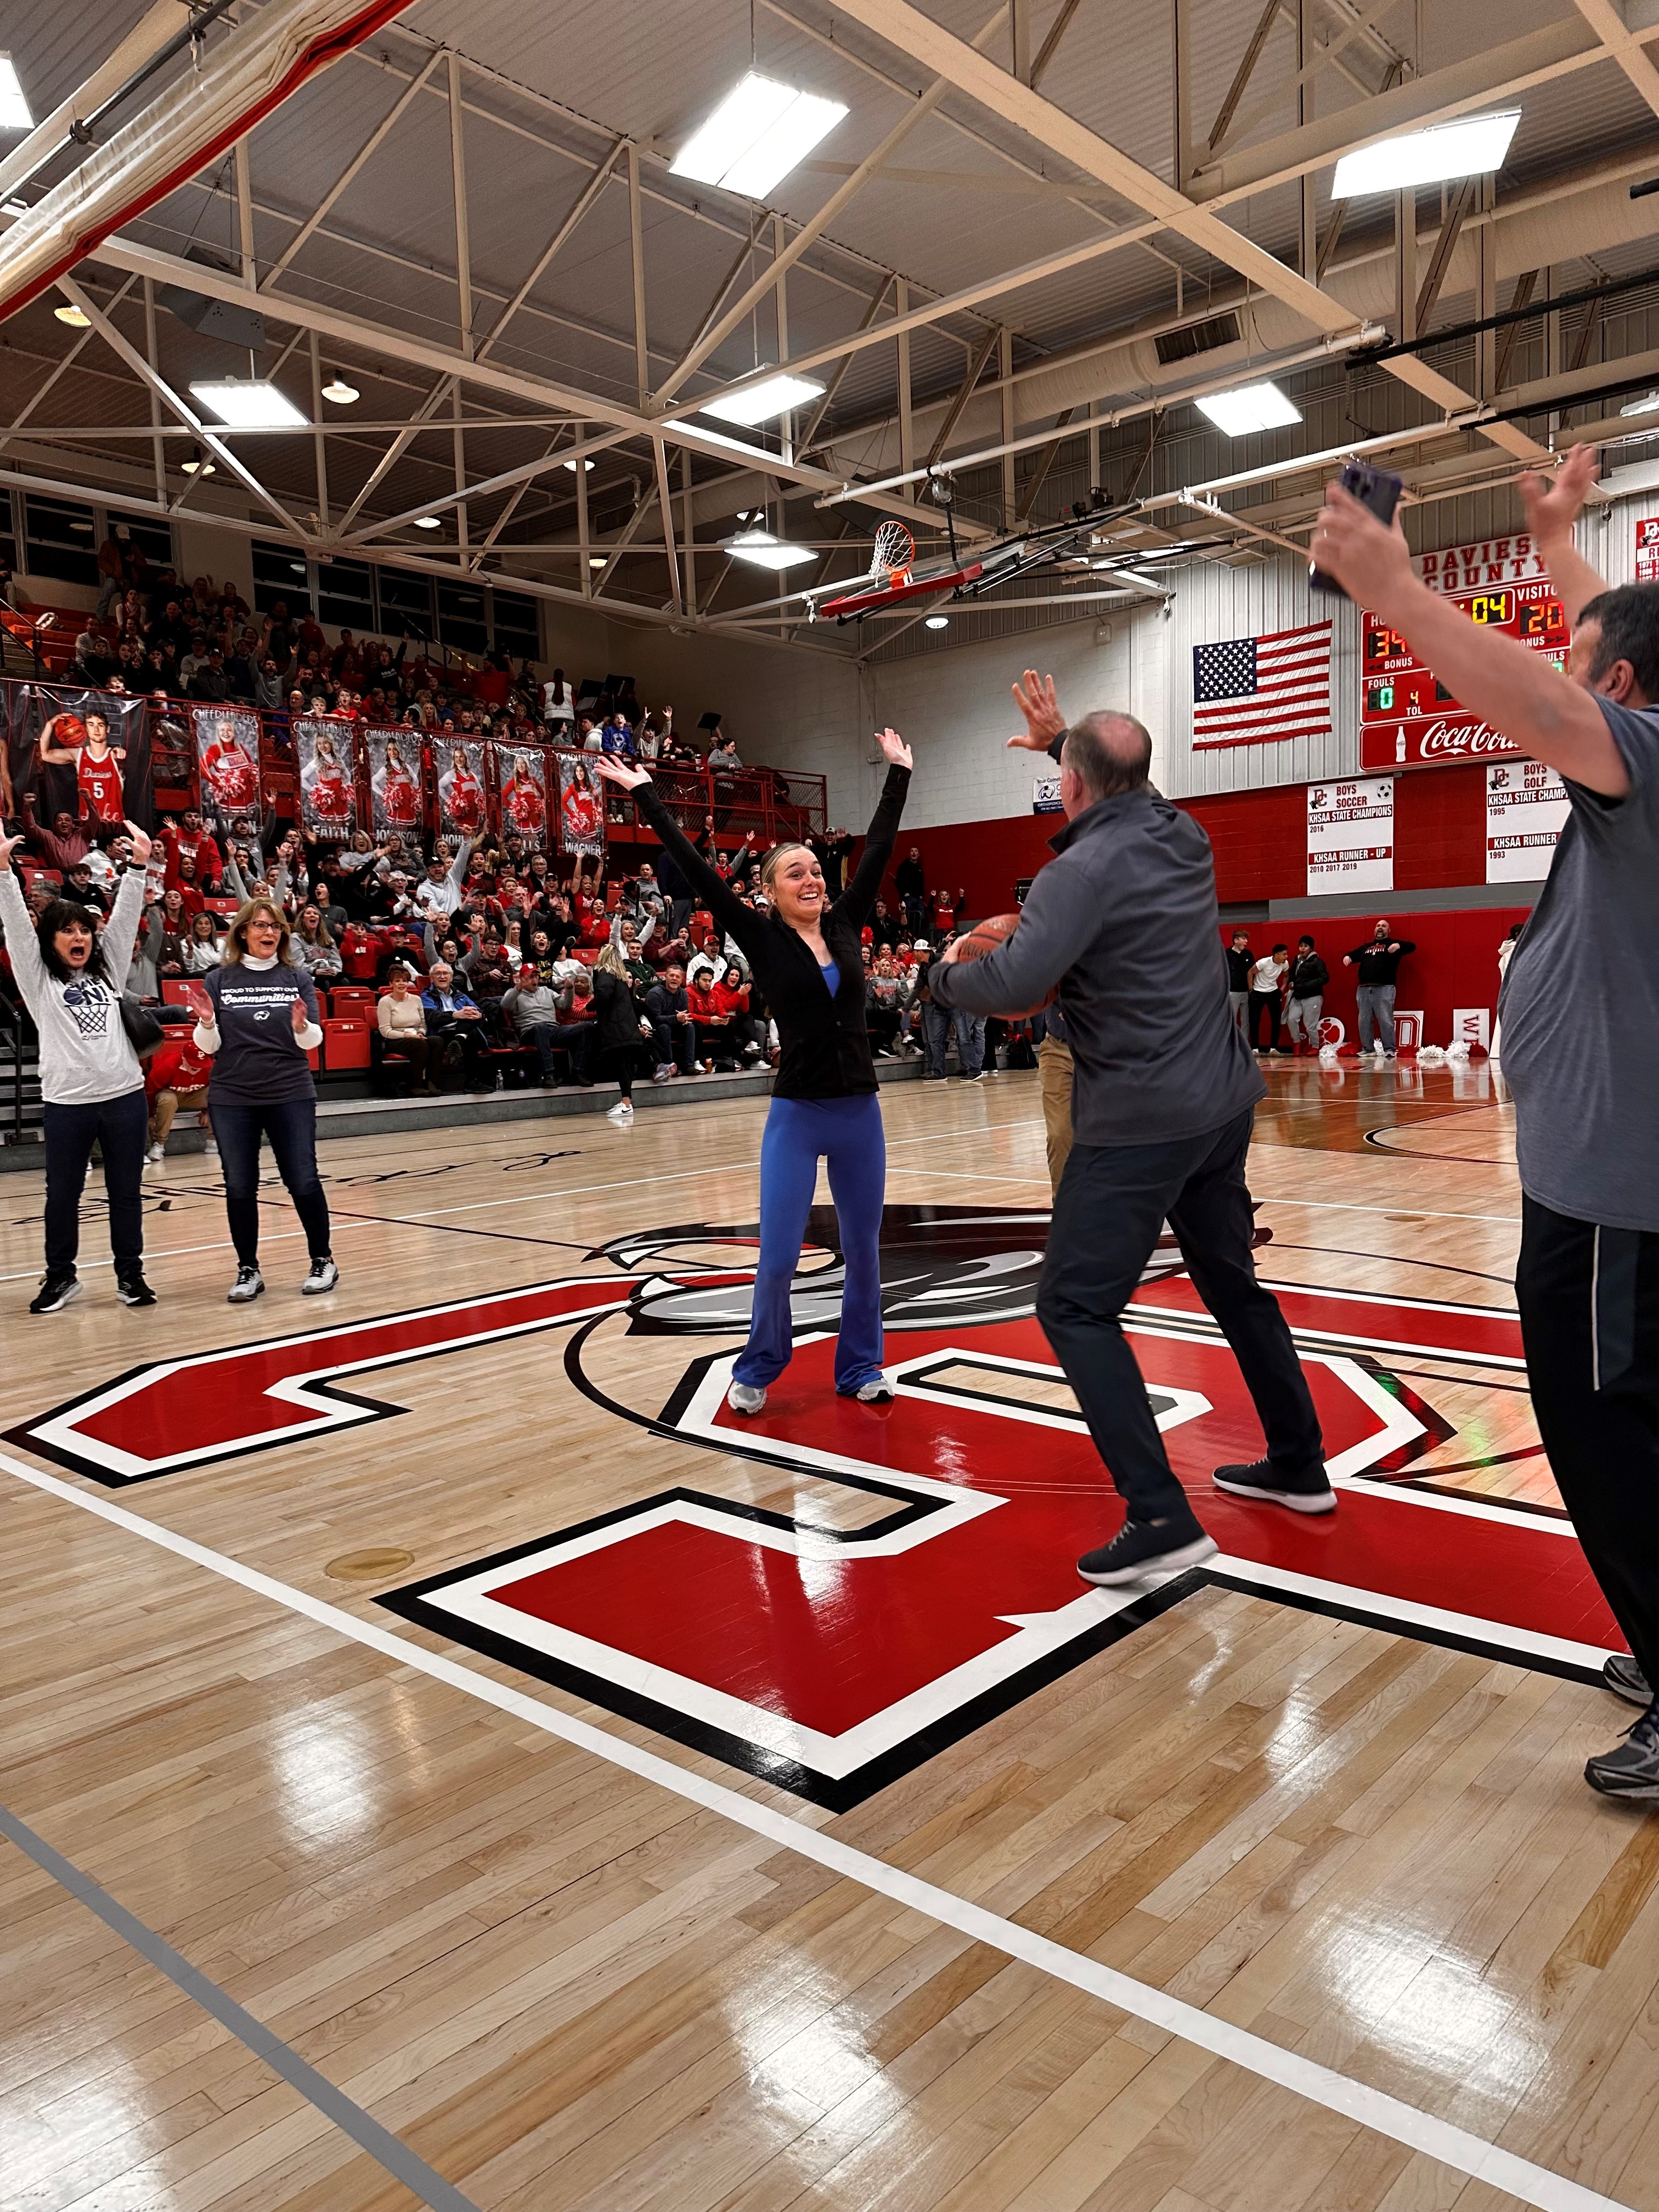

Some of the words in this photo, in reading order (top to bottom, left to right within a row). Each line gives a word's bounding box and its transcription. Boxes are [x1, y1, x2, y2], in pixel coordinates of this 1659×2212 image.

[1423, 535, 1537, 574] DAVIES
[1517, 584, 1558, 601] VISITO
[1528, 601, 1565, 633] 20
[1375, 630, 1406, 657] 34
[1519, 636, 1545, 647] ONUS
[1384, 657, 1413, 669] BONUS
[1368, 676, 1395, 689] FOULS
[1380, 687, 1394, 709] 0
[1410, 691, 1419, 704] 4
[1406, 707, 1423, 716] TOL
[1524, 763, 1547, 775] BOYS
[1524, 777, 1547, 788] GOLF
[93, 782, 104, 799] 5
[1336, 785, 1356, 796] BOYS
[1336, 796, 1368, 808] SOCCER
[1488, 793, 1513, 806] KHSAA
[1515, 791, 1537, 803] STATE
[1310, 812, 1330, 824] KHSAA
[1331, 810, 1351, 821] STATE
[1352, 805, 1392, 819] CHAMPIONS
[1489, 808, 1505, 816] 1995
[313, 825, 349, 840] FAITH
[1494, 837, 1521, 848] KHSAA
[1523, 833, 1557, 846] RUNNER
[565, 842, 602, 856] WAGNER
[1314, 852, 1337, 864] KHSAA
[1339, 850, 1368, 861] RUNNER
[1376, 848, 1386, 858] UP
[1489, 851, 1505, 859] 1993
